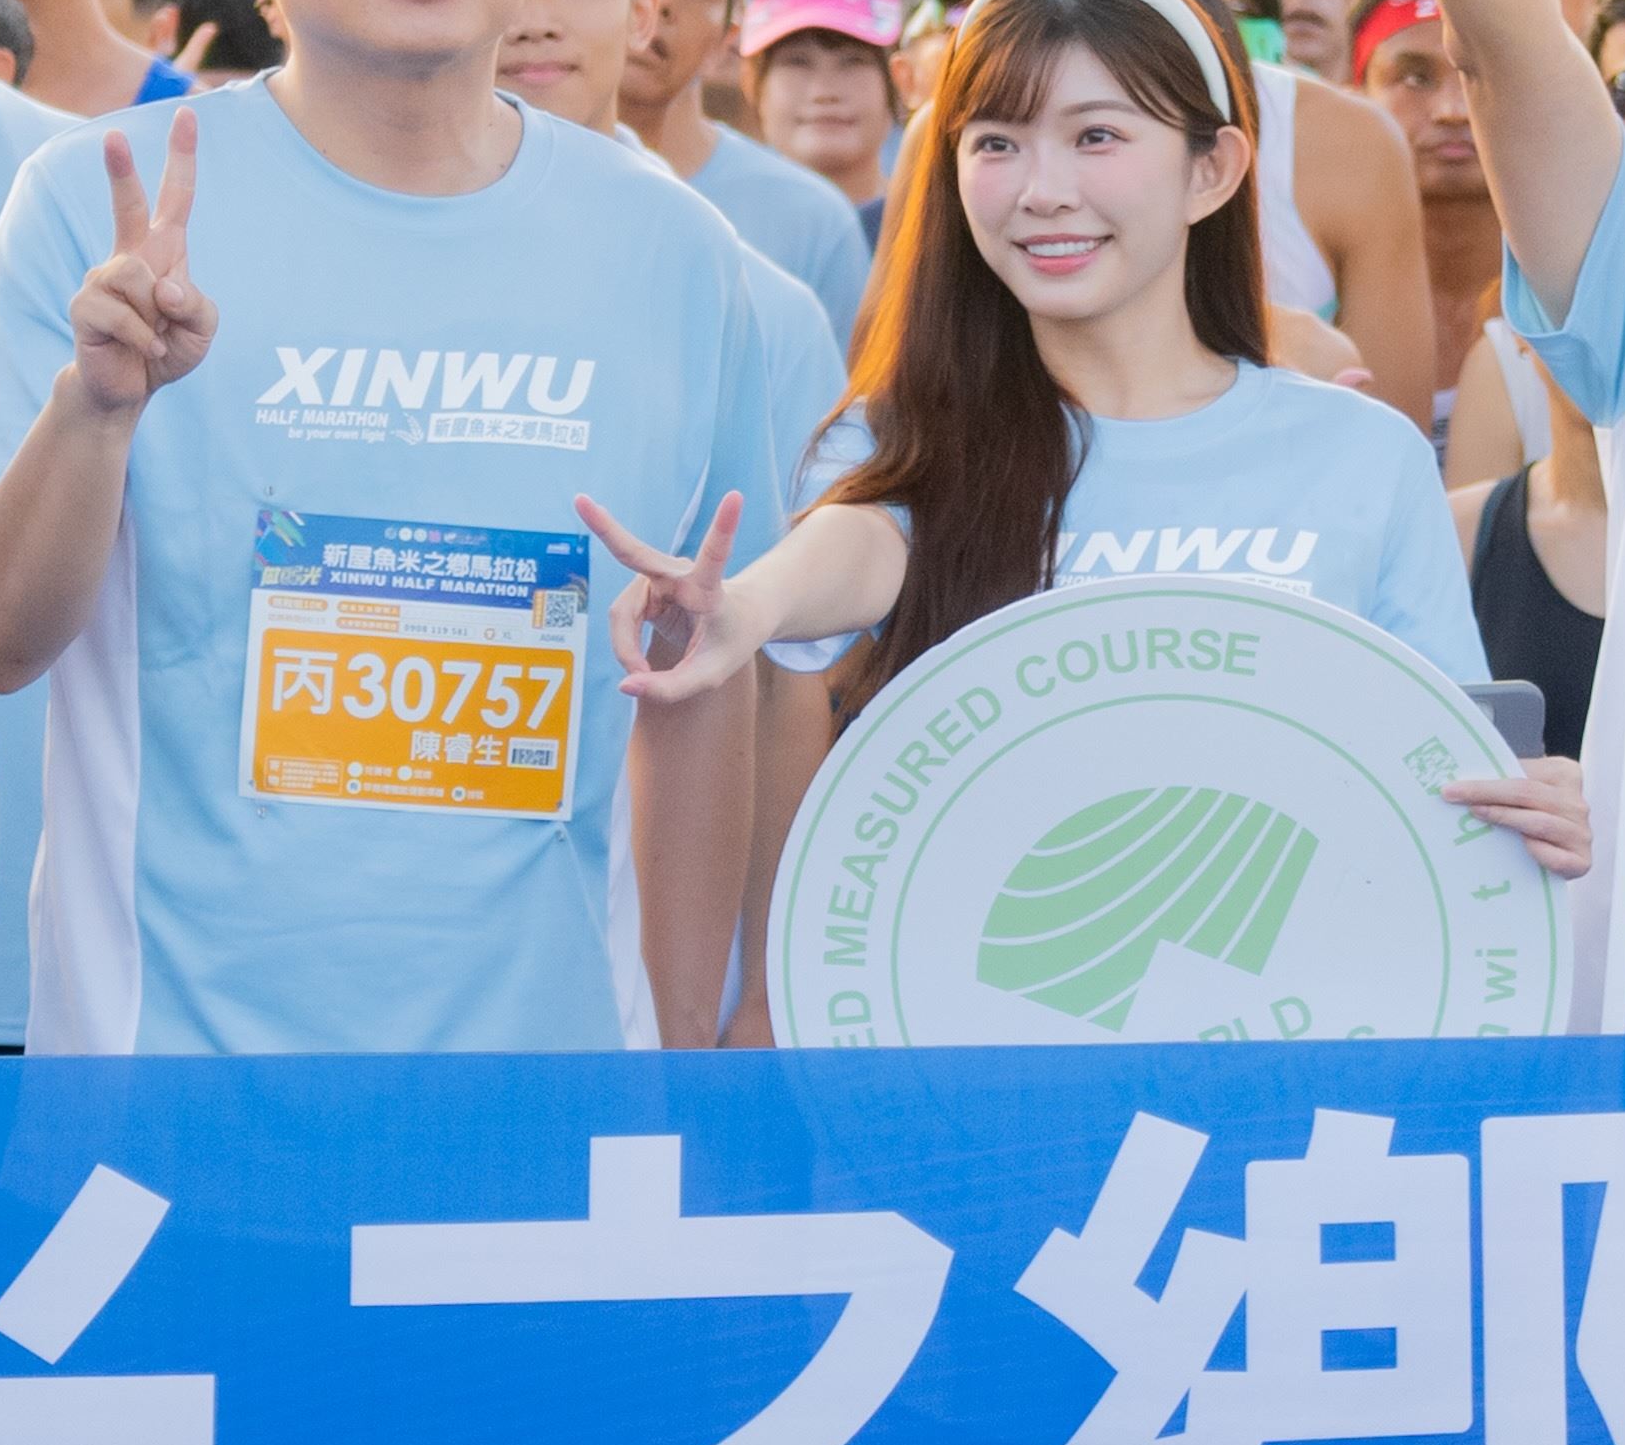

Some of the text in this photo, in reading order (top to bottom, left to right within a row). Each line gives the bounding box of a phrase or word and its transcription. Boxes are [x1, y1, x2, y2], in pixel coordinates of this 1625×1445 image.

[255, 347, 596, 415] XINWU
[255, 408, 389, 429] HALF MARATHON
[287, 427, 302, 439] be
[305, 430, 331, 442] your
[334, 431, 359, 441] own
[434, 417, 588, 446] 新屋魚米之鄉馬拉松
[322, 543, 538, 584] 新屋魚米之鄉馬拉松
[1053, 527, 1319, 576] INWU
[329, 571, 387, 587] XINWU
[391, 575, 435, 591] HALF
[439, 581, 530, 598] MARATHON
[409, 729, 504, 767] 陳睿生
[822, 684, 1004, 968] MEASURED
[1014, 626, 1262, 699] COURSE
